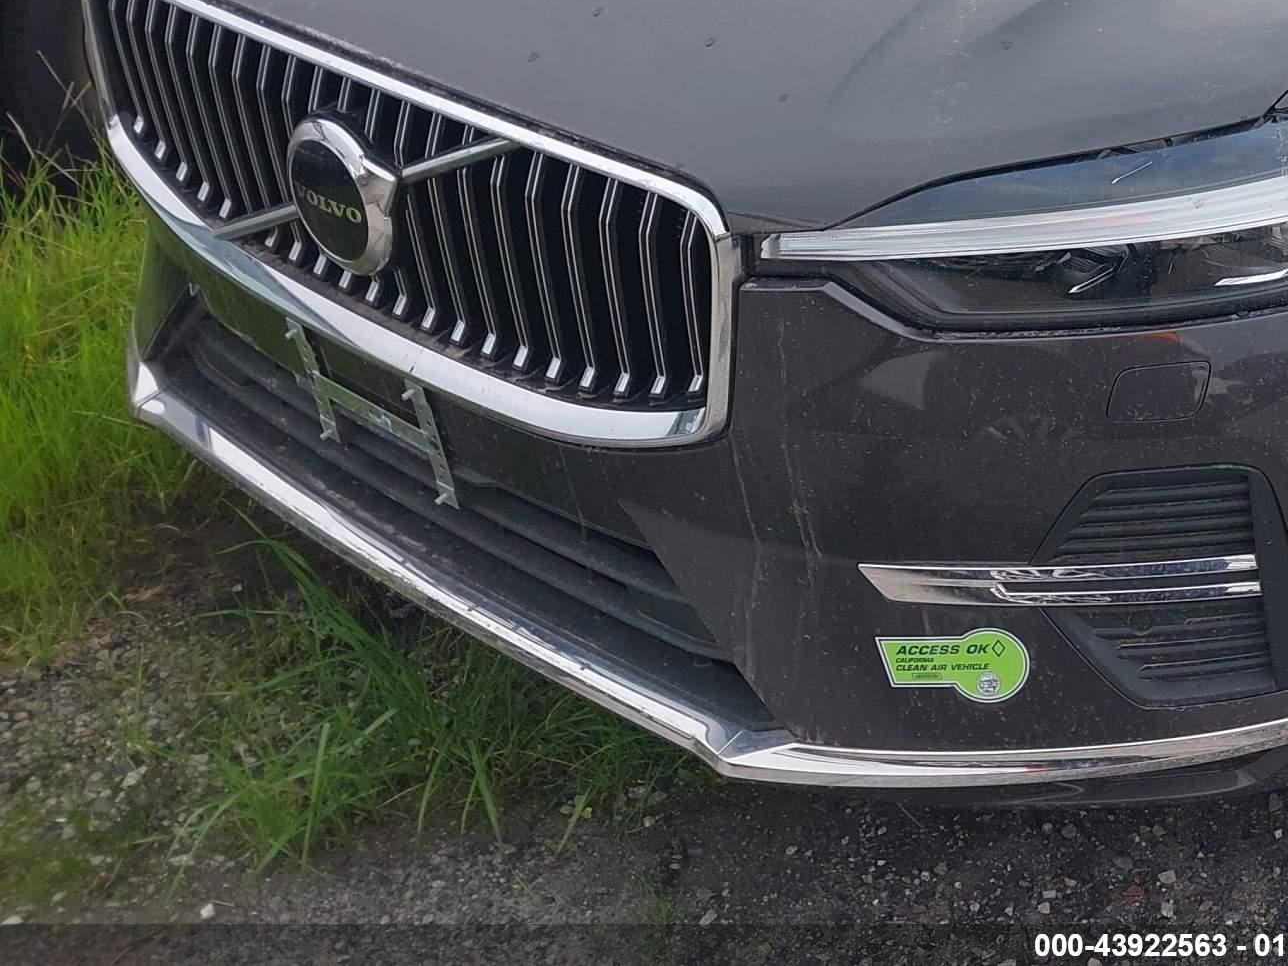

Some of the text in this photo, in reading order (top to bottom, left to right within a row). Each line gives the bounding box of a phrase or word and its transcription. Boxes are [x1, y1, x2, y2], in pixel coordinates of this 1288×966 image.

[293, 180, 362, 224] VOLVO
[896, 643, 991, 655] ACCESS OK
[951, 663, 991, 671] VEHICLE
